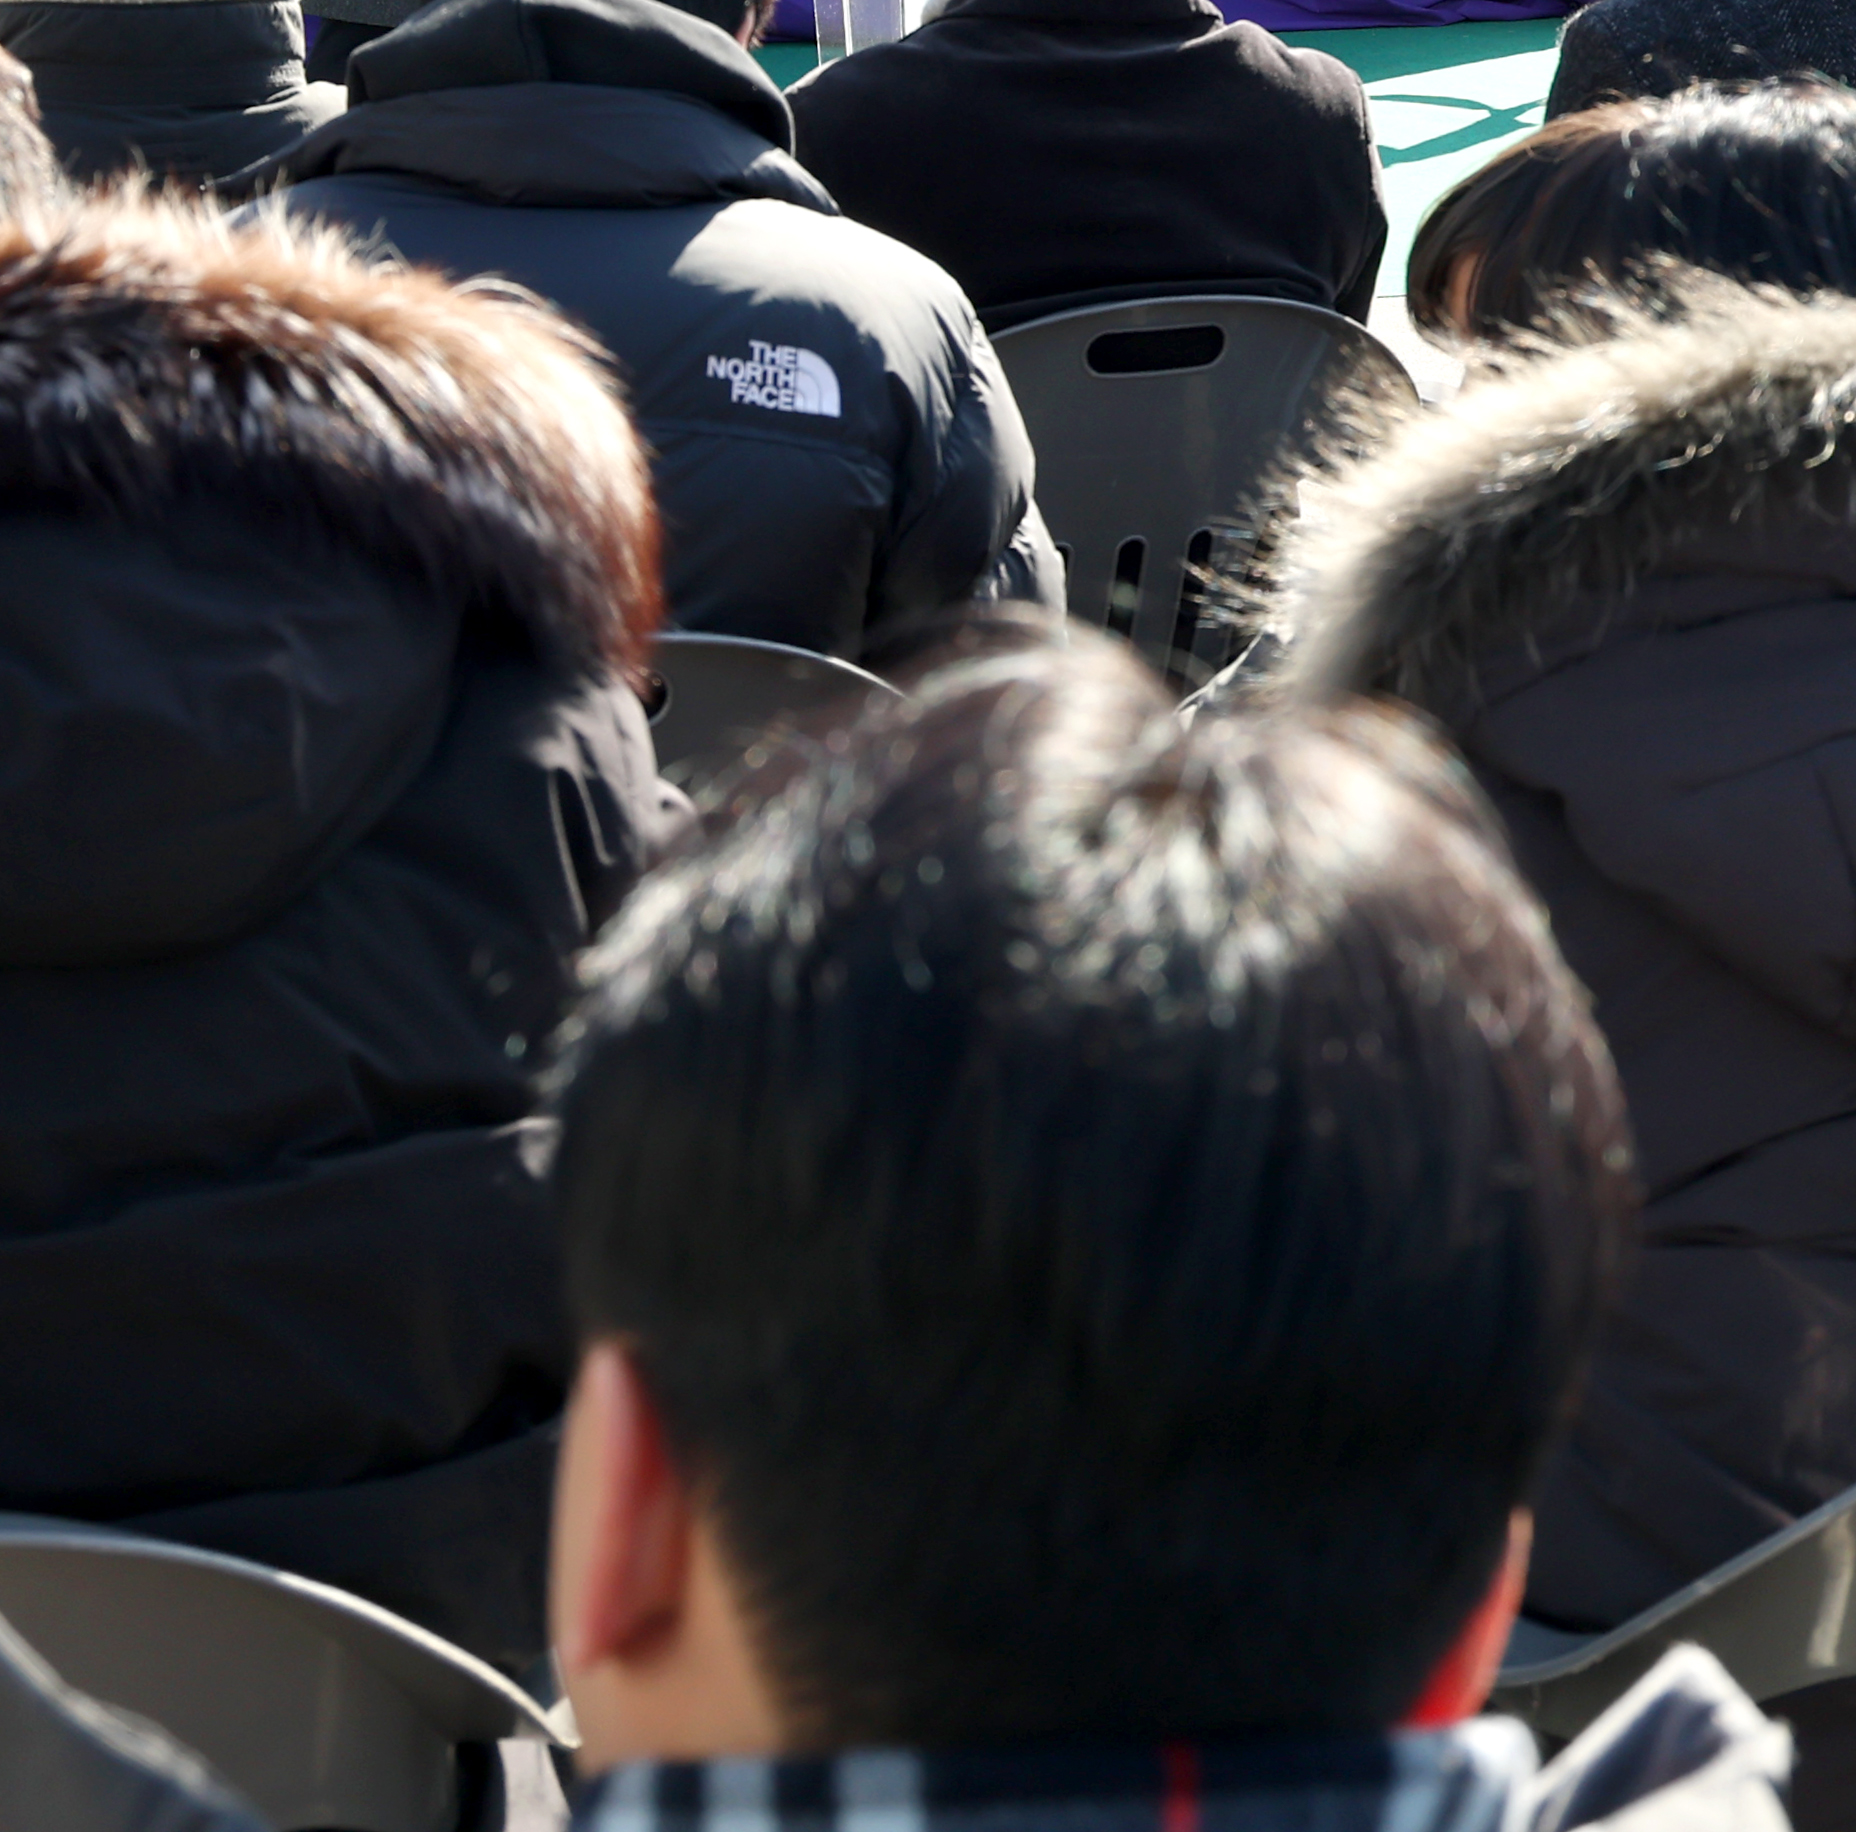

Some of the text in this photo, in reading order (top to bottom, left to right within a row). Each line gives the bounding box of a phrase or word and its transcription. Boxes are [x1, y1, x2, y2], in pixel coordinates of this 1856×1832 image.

[748, 339, 796, 368] THE
[706, 354, 794, 389] NORTH
[730, 379, 795, 412] FACE
